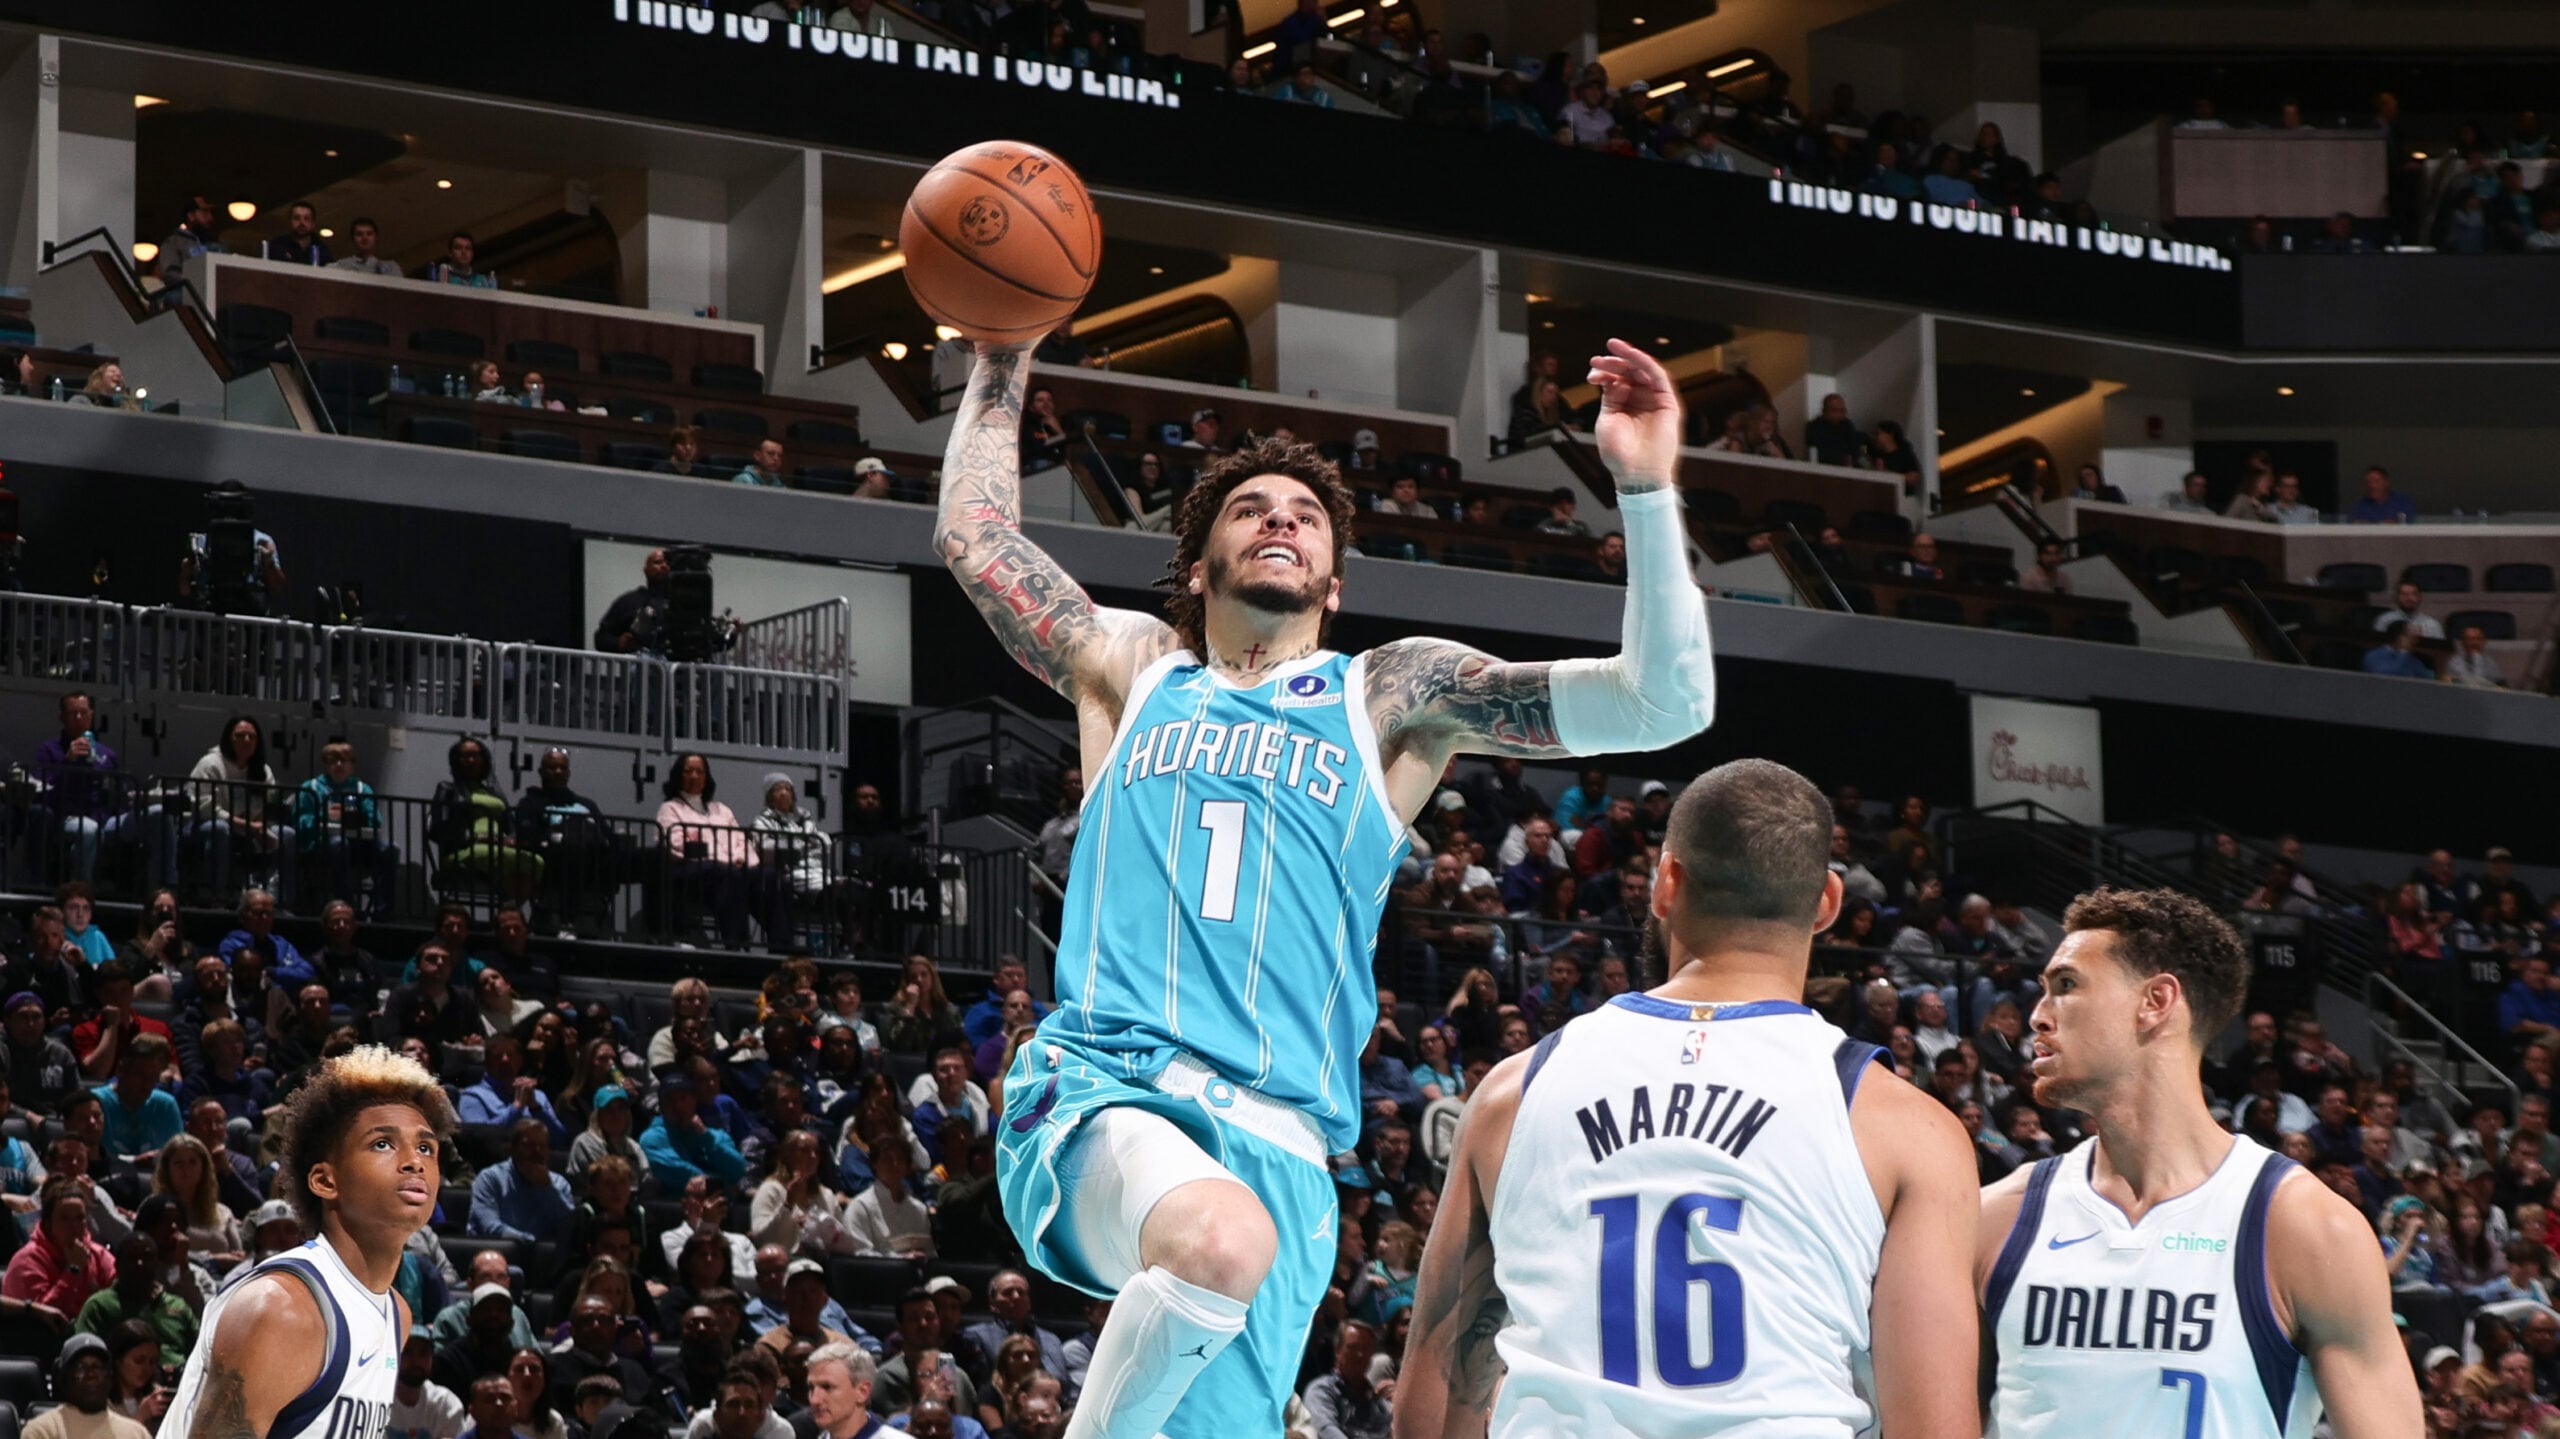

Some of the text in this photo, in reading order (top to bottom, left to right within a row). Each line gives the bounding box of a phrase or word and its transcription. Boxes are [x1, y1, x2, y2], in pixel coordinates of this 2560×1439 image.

[1122, 719, 1348, 809] HORNETS
[1198, 799, 1248, 924] 1
[888, 885, 929, 912] 114
[2263, 944, 2296, 968] 115
[2470, 960, 2502, 984] 116
[1575, 1083, 1778, 1164] MARTIN
[2162, 1232, 2228, 1254] chime
[1587, 1191, 1747, 1390] 16
[2023, 1284, 2217, 1353] DALLAS
[324, 1394, 394, 1439] DALLA
[2160, 1367, 2207, 1439] 7
